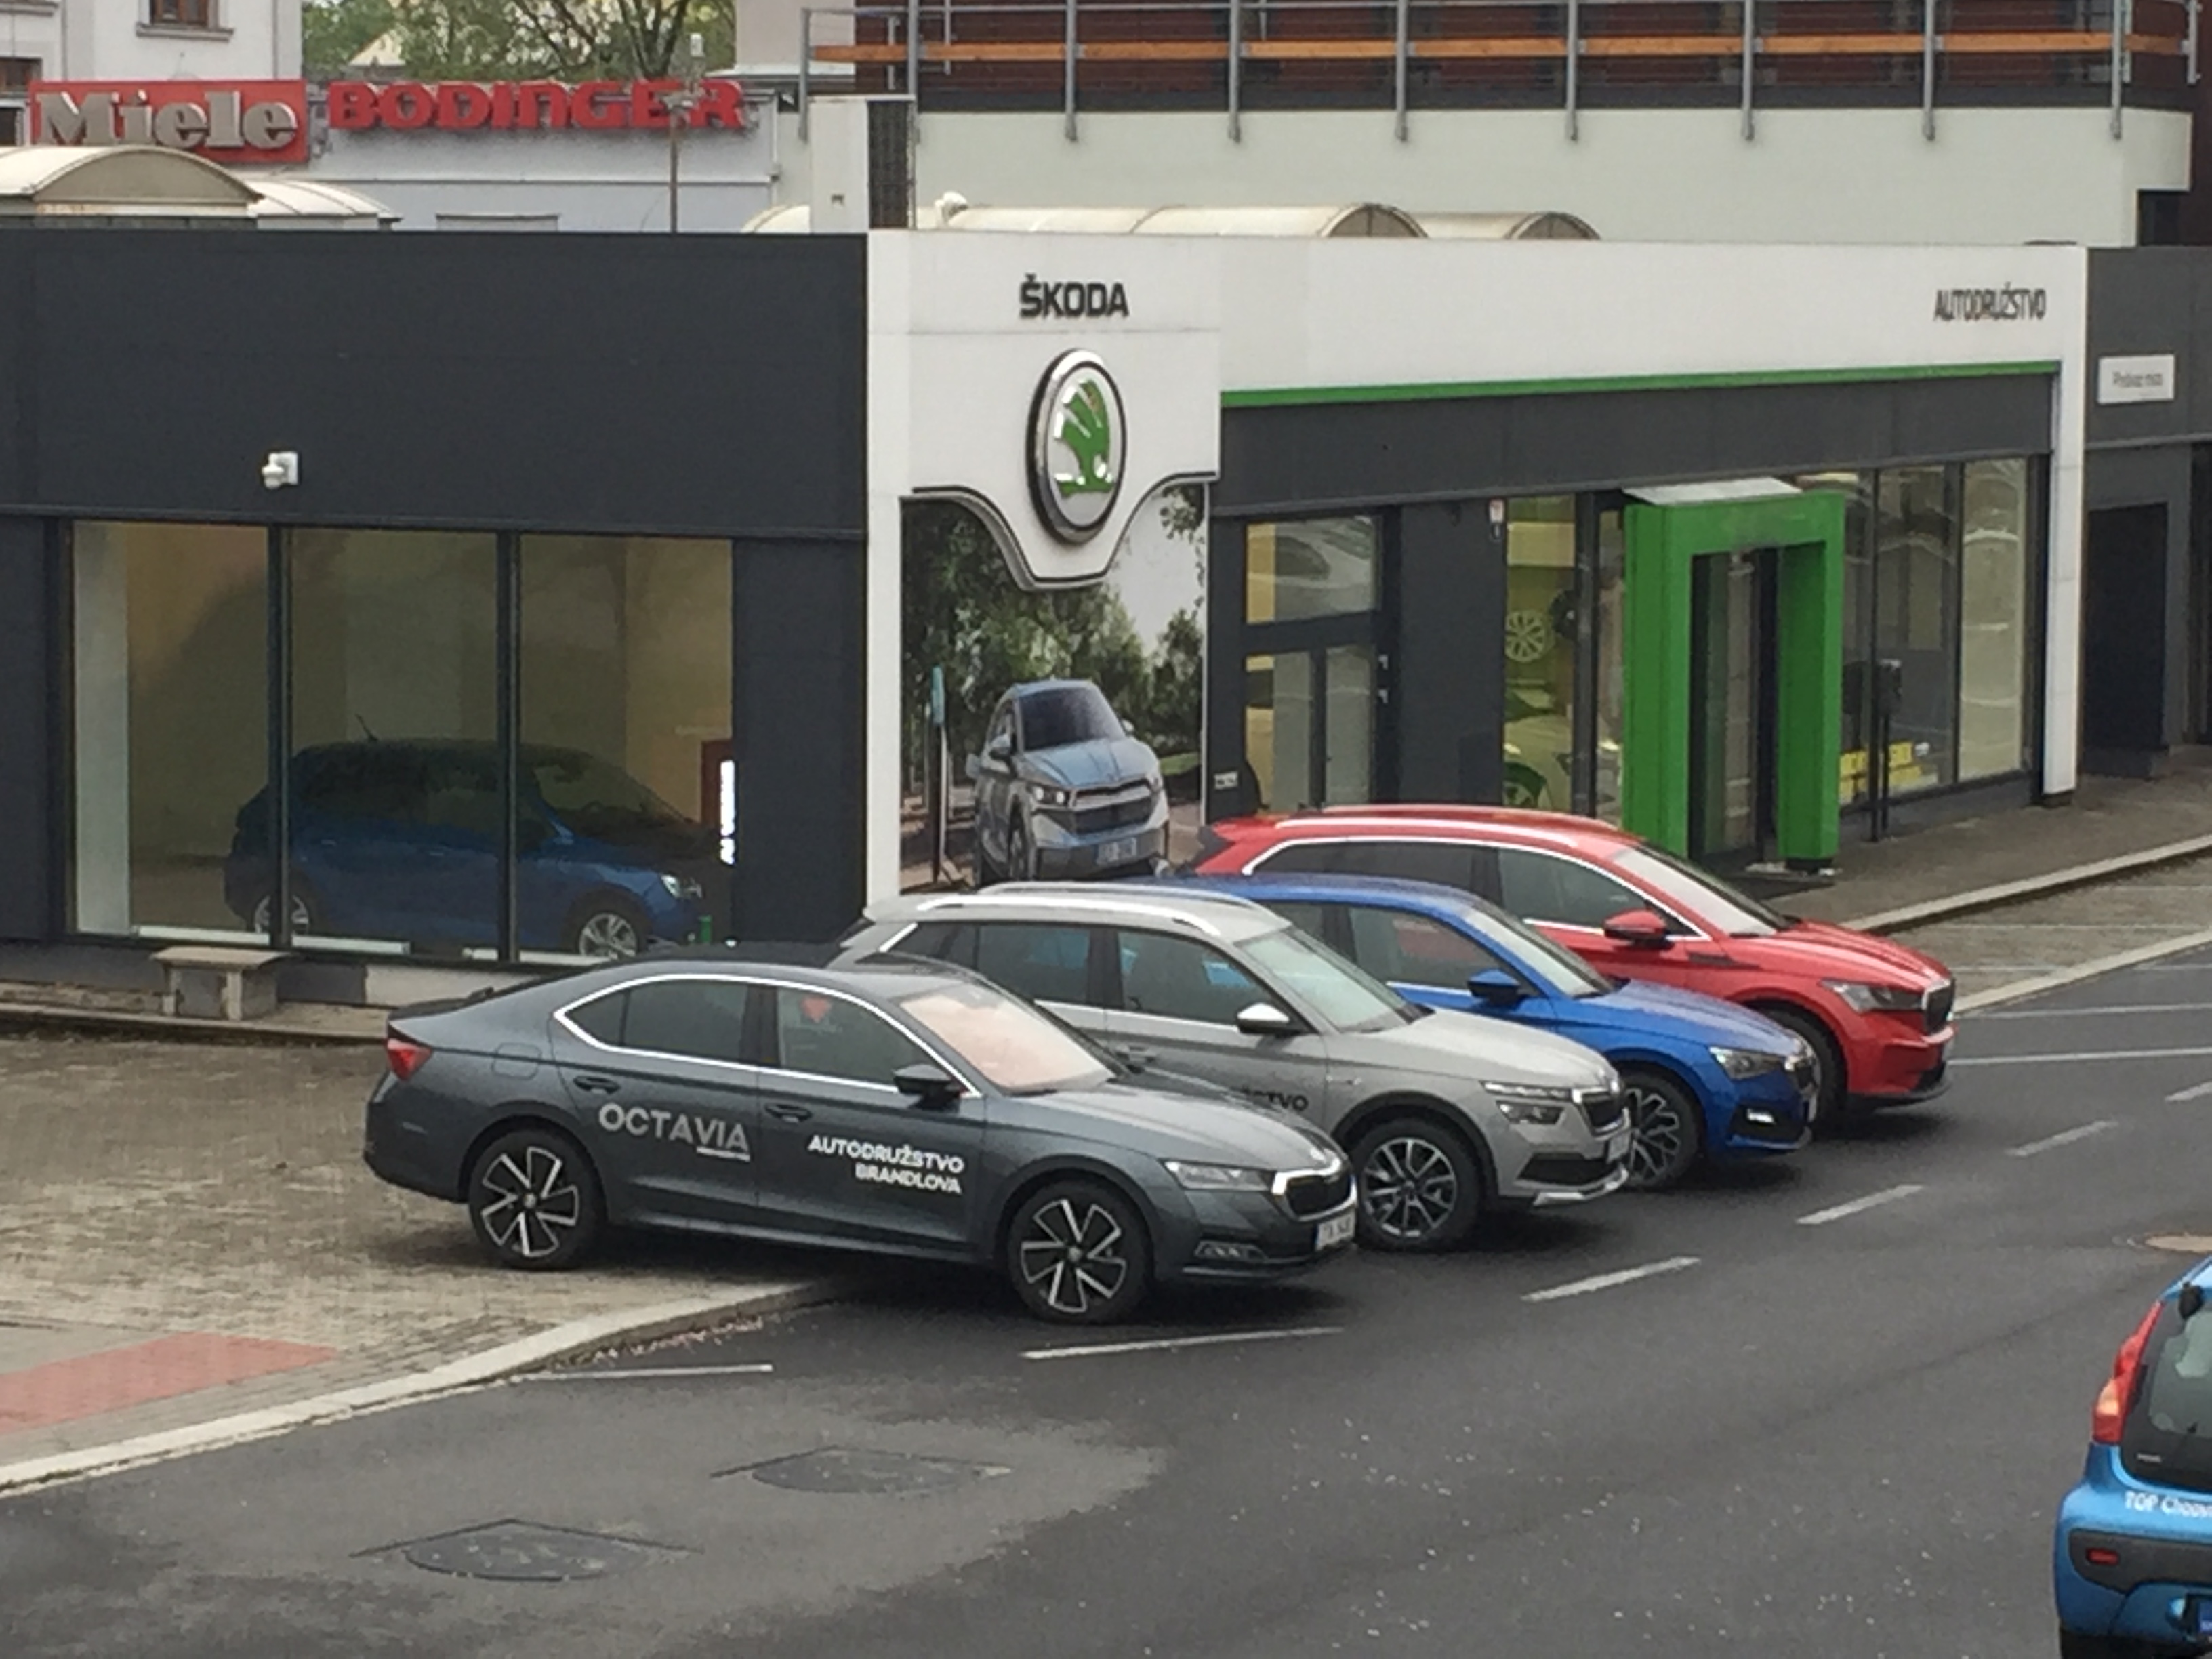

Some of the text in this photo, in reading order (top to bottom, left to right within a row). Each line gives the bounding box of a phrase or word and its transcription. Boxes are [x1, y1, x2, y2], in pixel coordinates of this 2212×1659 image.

[36, 89, 297, 149] Miele
[328, 79, 747, 129] BODINGER
[1019, 272, 1130, 319] ŠKODA
[1933, 281, 2047, 321] AUTODRUŽSTVO
[598, 1102, 751, 1153] OCTAVIA
[807, 1134, 965, 1174] AUTODRUŽSTVO
[855, 1162, 962, 1195] BRANDLOVA
[2125, 1490, 2159, 1512] TOP
